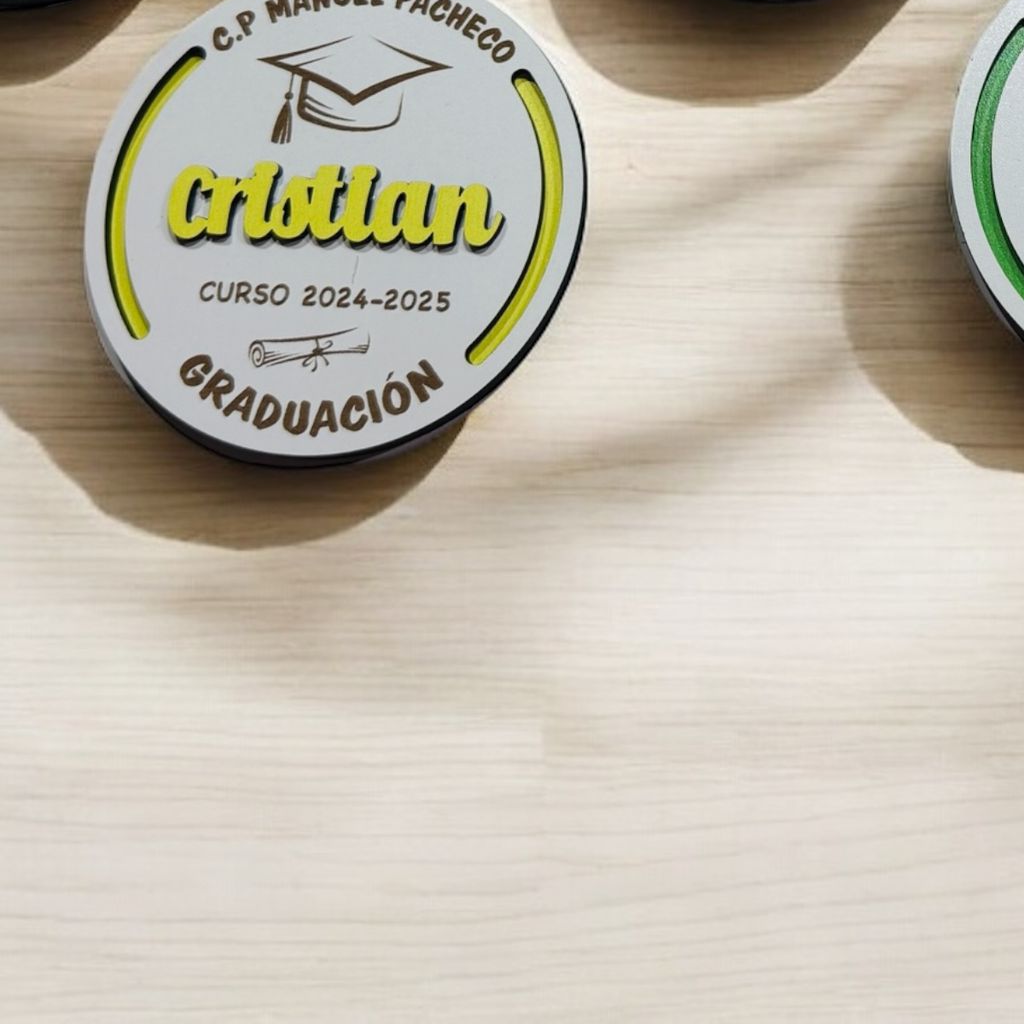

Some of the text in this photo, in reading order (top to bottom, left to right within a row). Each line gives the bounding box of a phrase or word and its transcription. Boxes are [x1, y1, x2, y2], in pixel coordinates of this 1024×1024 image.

[212, 9, 256, 51] C.P
[167, 160, 505, 250] Cristian
[200, 281, 452, 312] CURSO 2024-2025
[179, 354, 444, 437] GRADUACIÓN
